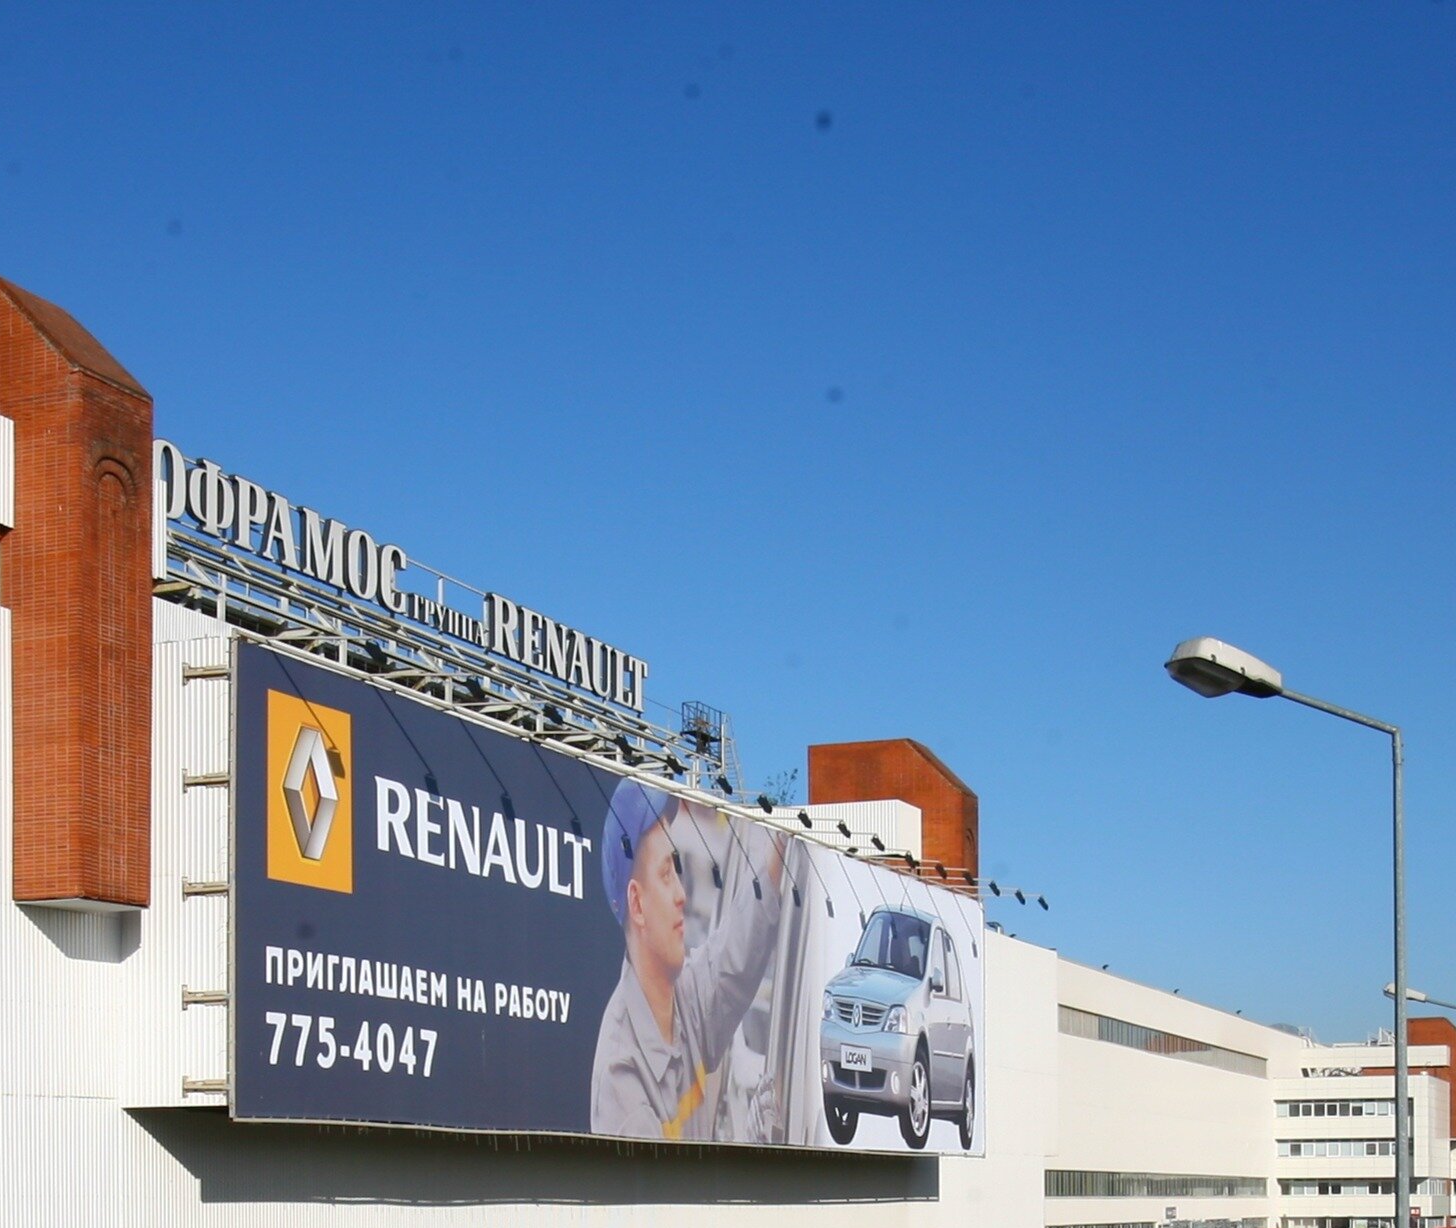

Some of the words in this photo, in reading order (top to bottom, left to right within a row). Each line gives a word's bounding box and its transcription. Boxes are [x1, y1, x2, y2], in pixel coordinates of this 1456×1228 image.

[489, 593, 648, 713] RENAULT
[374, 776, 592, 900] RENAULT
[265, 945, 448, 1008] ПРИГЛАШАЕМ
[457, 976, 487, 1014] НА
[494, 982, 571, 1024] РАБОТУ
[265, 1011, 438, 1078] 775-4047
[845, 1051, 867, 1066] LOGAN
